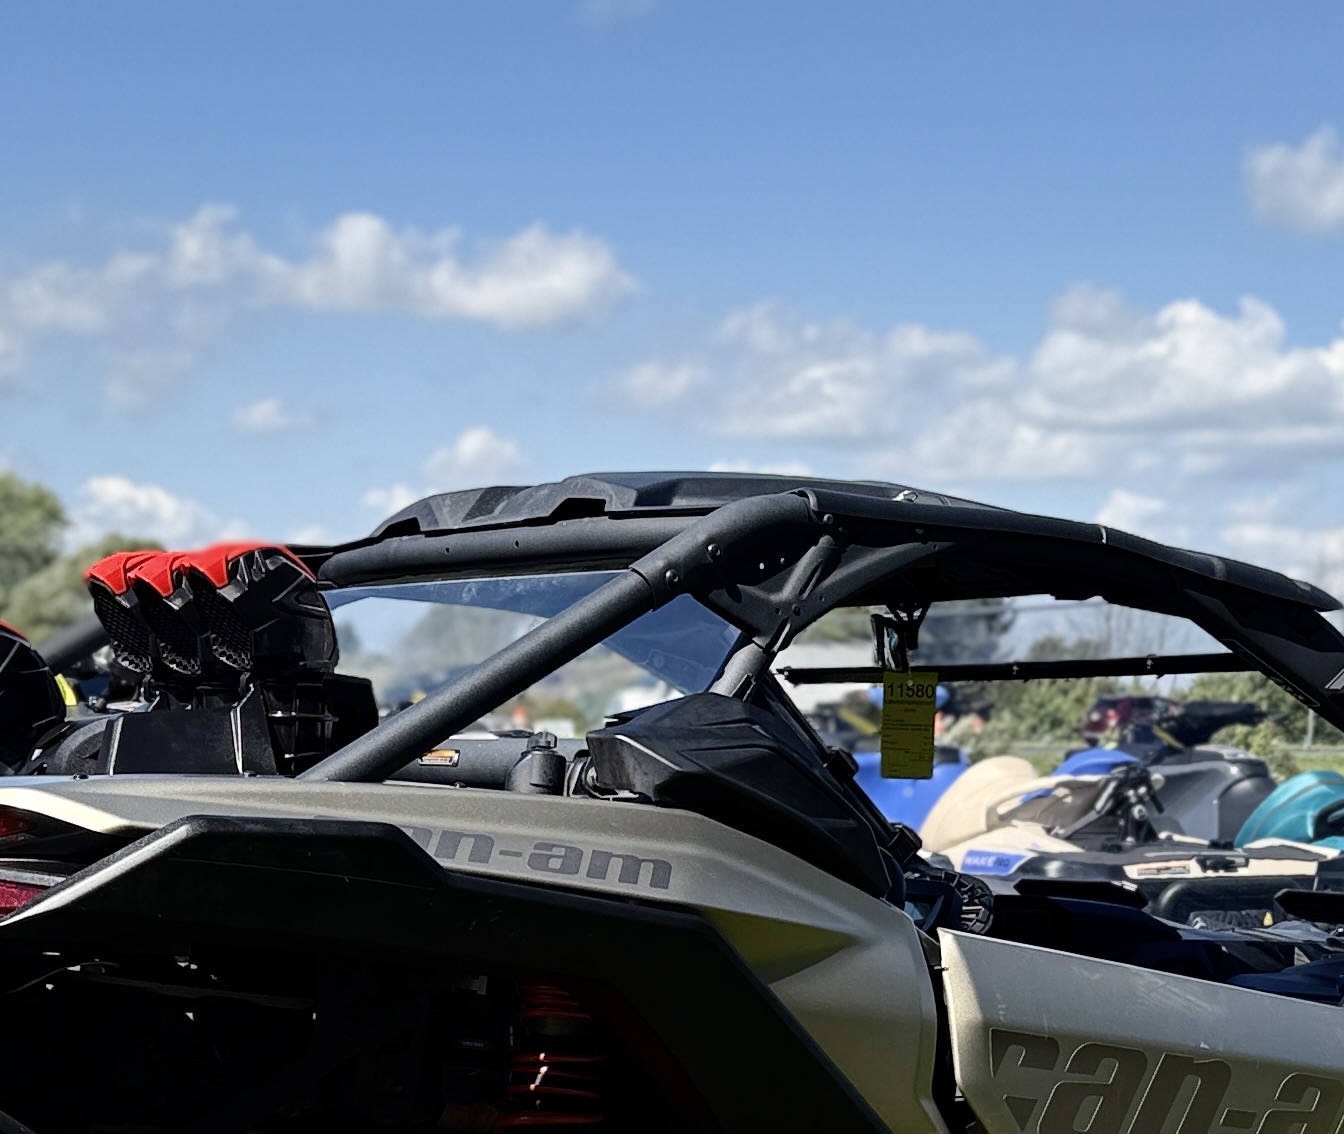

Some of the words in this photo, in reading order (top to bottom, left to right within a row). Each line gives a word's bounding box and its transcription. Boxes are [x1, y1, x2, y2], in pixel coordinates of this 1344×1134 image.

[887, 683, 935, 699] 11580
[397, 823, 672, 890] n-am
[964, 855, 996, 868] WAKE
